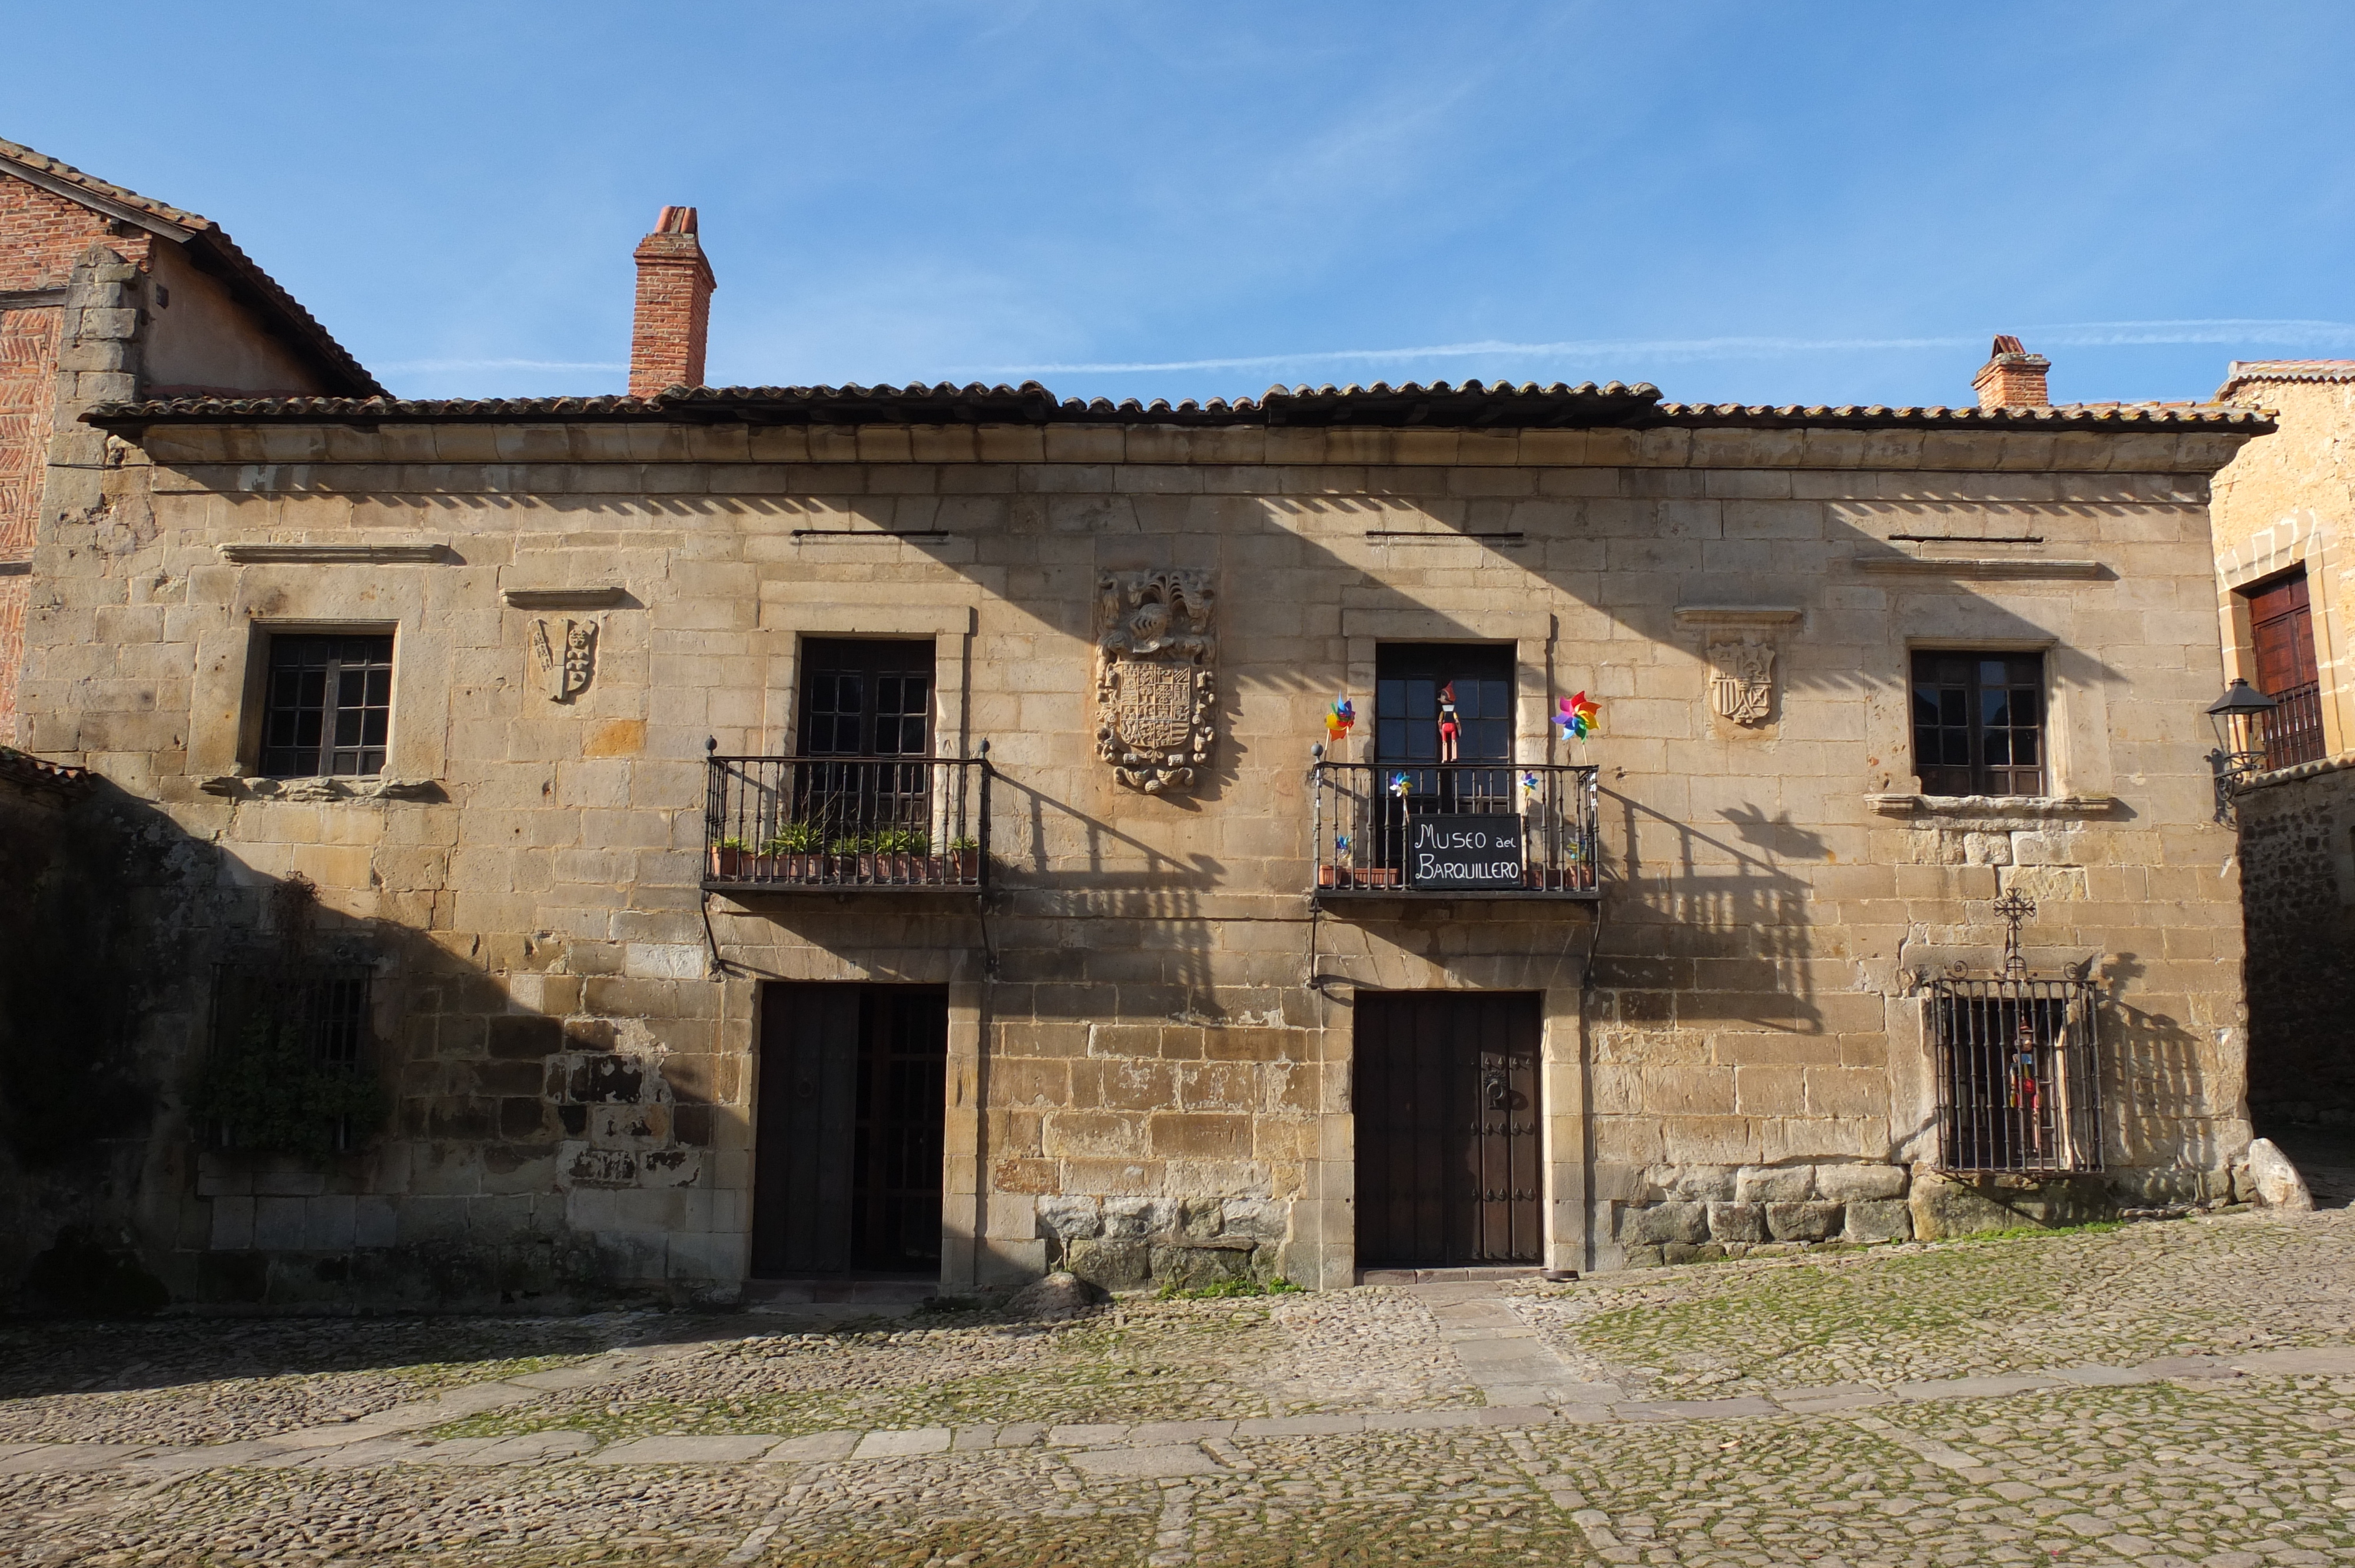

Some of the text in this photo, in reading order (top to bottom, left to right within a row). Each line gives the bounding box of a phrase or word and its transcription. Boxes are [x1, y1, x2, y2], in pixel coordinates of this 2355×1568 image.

[1414, 823, 1517, 849] MUSEO del
[1415, 853, 1519, 879] BARQUILLERO
